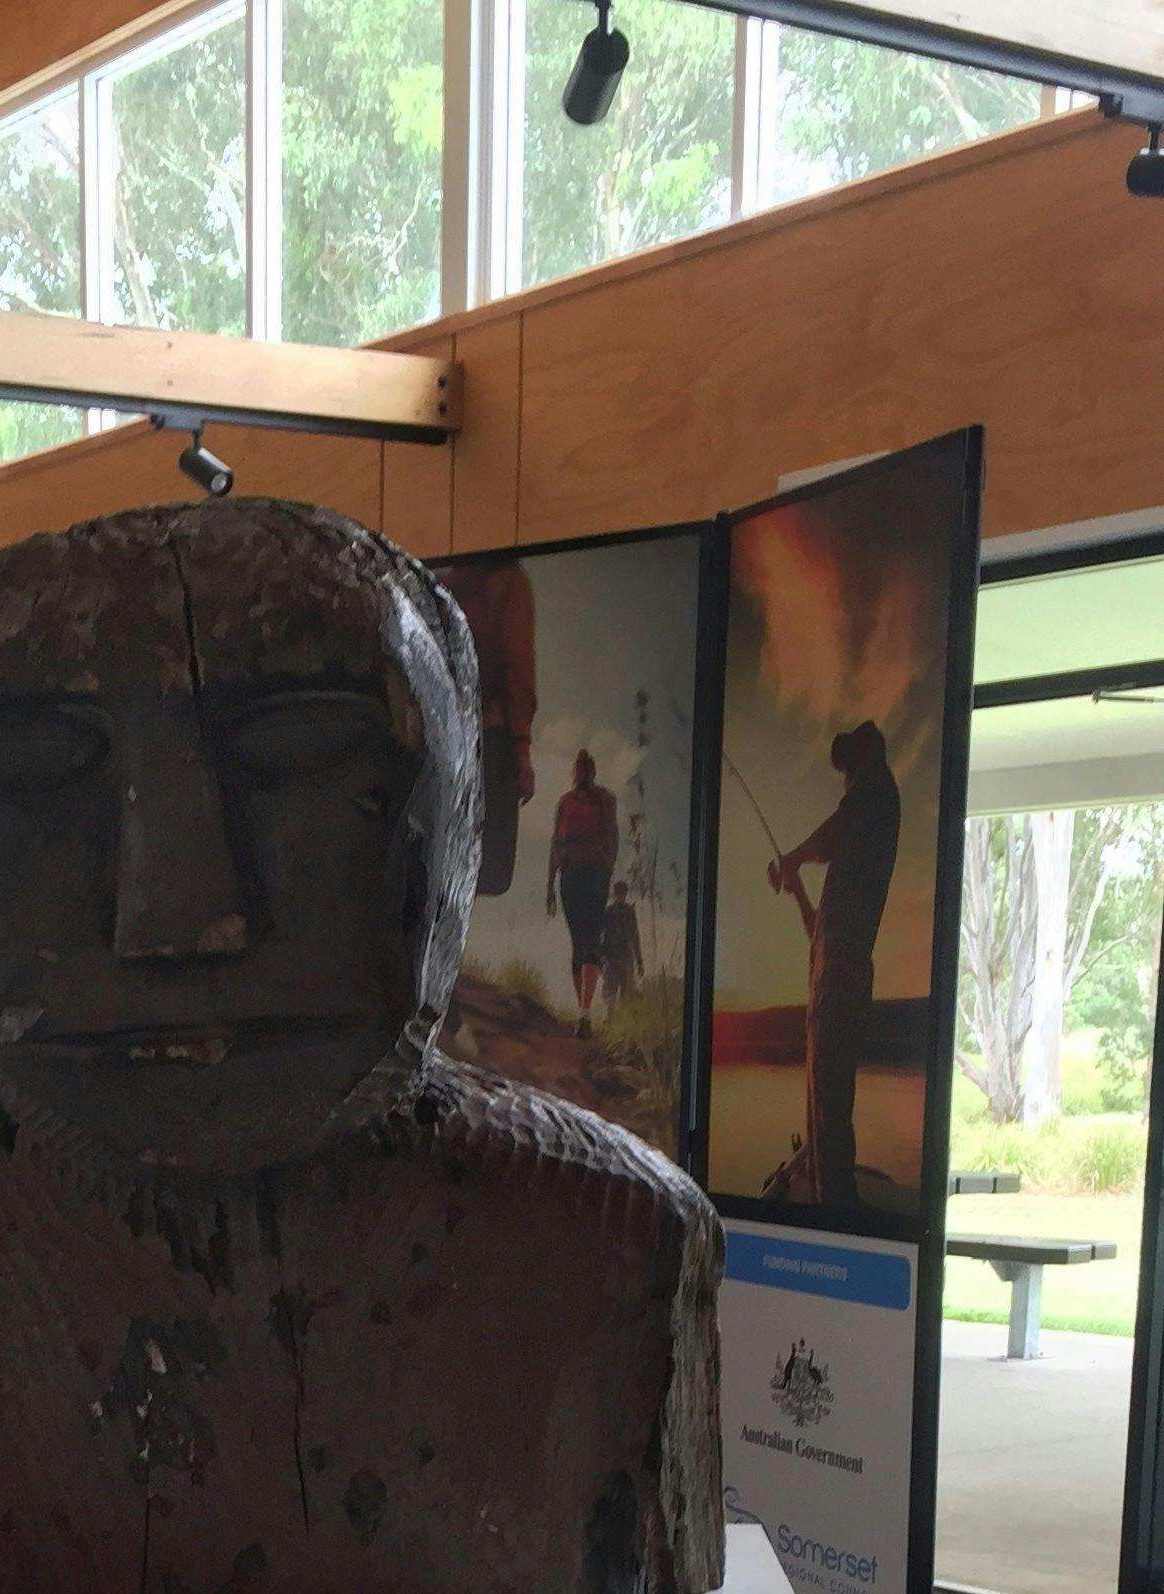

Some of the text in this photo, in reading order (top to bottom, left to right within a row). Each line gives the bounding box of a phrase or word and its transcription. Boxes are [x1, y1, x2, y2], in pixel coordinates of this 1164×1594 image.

[740, 1424, 864, 1474] Australian Government
[777, 1524, 877, 1584] Somerset
[783, 1562, 825, 1590] GIONAL
